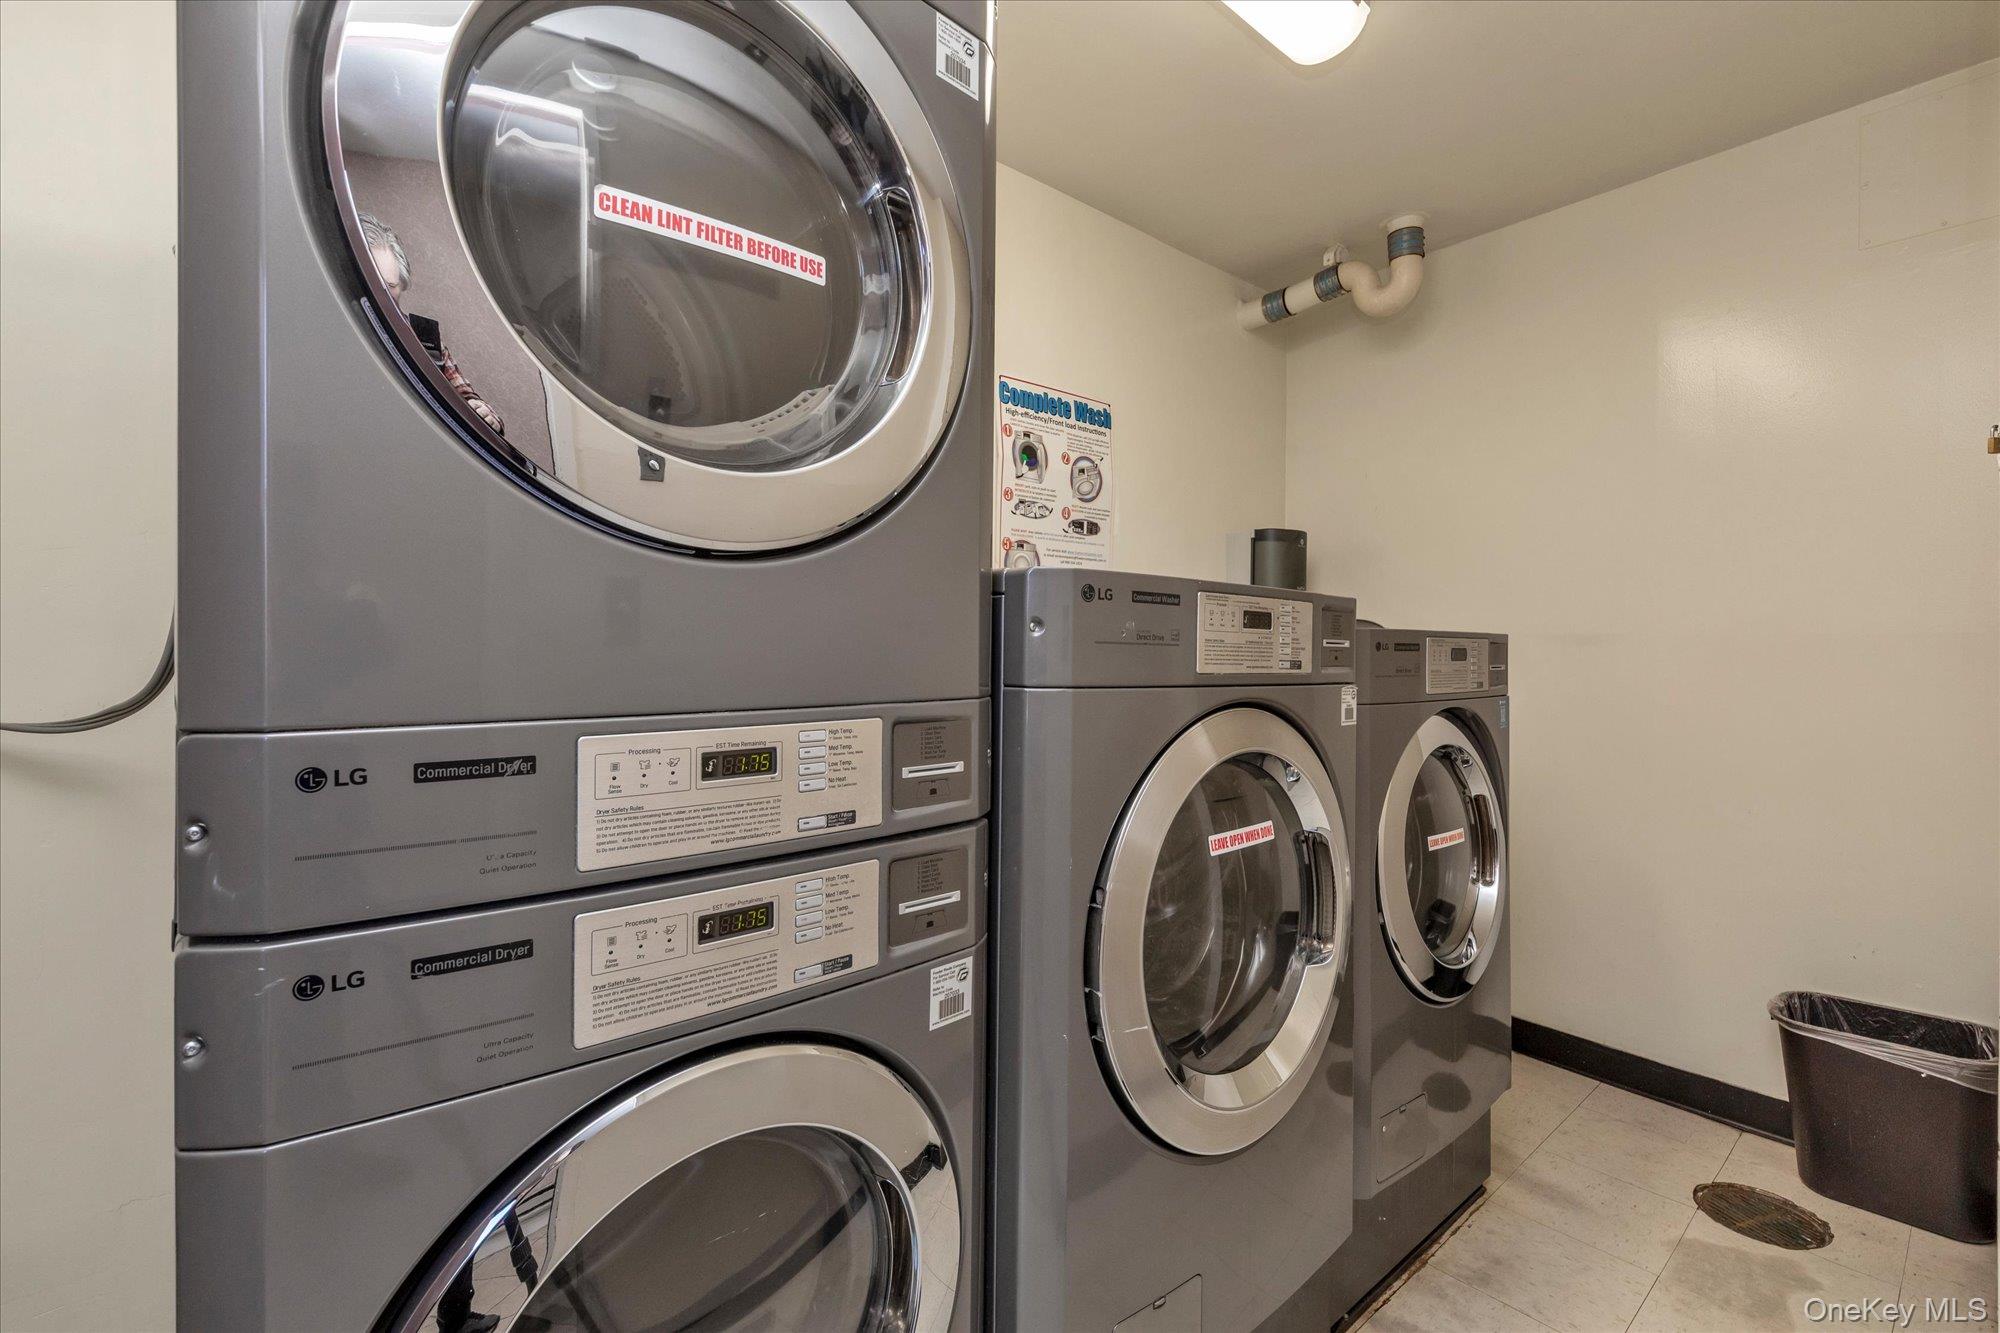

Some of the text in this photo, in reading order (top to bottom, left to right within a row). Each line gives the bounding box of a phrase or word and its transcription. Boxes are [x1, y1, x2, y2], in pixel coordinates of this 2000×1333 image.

[599, 192, 823, 278] CLEAN LINT FILTER BEFORE USE
[999, 381, 1071, 419] Complete
[1074, 400, 1111, 429] Wash
[1065, 421, 1076, 430] load
[1098, 588, 1113, 601] LG
[1134, 594, 1180, 604] Commercial Washer
[628, 747, 661, 756] Processing
[740, 740, 766, 748] Remaining
[738, 753, 770, 771] 1.75
[334, 767, 368, 787] LG
[417, 764, 495, 779] Commercial
[596, 808, 609, 816] Dryer
[610, 806, 628, 814] Safety
[1210, 824, 1273, 851] LEAVE OPEN WHEN DONE
[506, 849, 536, 859] Capacity
[501, 863, 536, 871] Operation
[625, 917, 658, 928] Processing
[736, 908, 767, 930] 1.75
[414, 945, 530, 975] Commercial Dryer
[332, 970, 365, 993] LG
[592, 975, 640, 991] Dryer Safety Rules
[503, 1033, 534, 1044] Capacity
[476, 1045, 534, 1063] Quiet Operation
